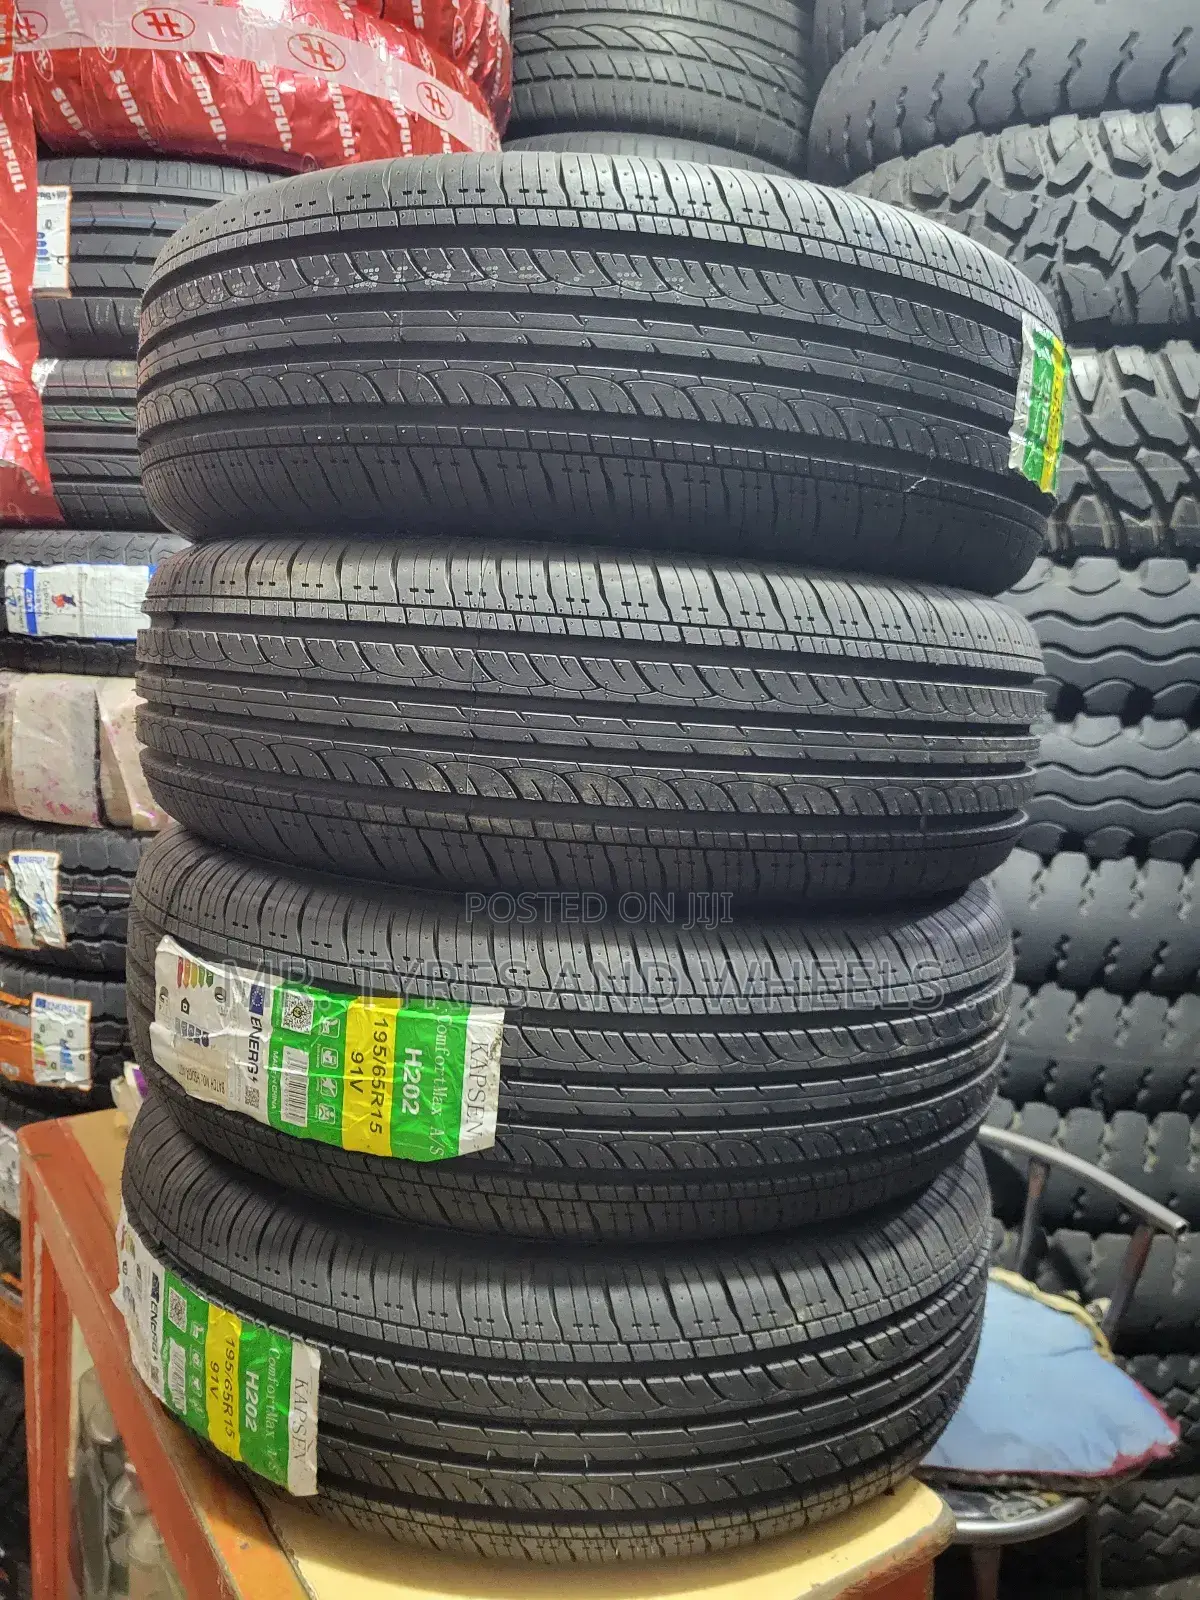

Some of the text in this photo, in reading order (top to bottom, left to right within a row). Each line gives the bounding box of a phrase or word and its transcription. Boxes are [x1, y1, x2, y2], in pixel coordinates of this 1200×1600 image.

[351, 1050, 364, 1094] 91V
[370, 1017, 388, 1135] 195/65R15
[402, 1048, 423, 1115] H202
[464, 1040, 490, 1138] KAPSEN
[210, 1360, 220, 1400] 91V
[221, 1338, 238, 1440] 195/65R15
[244, 1369, 260, 1433] H202
[292, 1378, 309, 1461] KAPSEN
